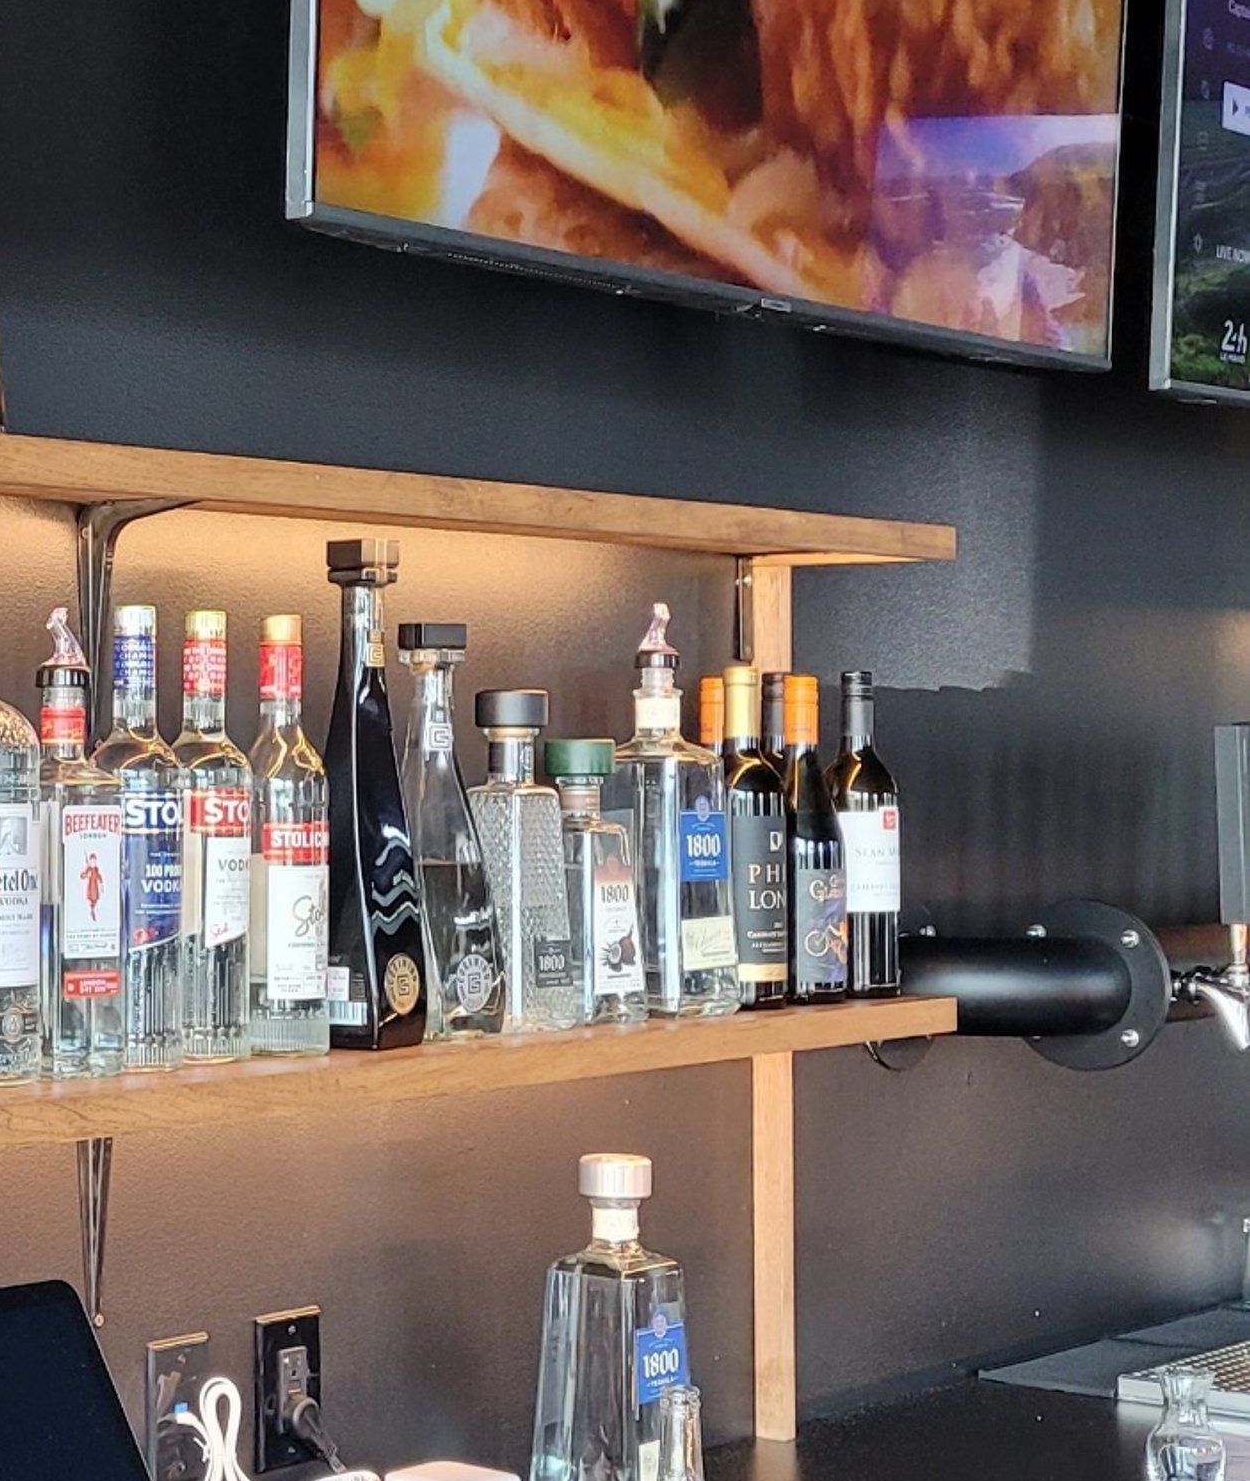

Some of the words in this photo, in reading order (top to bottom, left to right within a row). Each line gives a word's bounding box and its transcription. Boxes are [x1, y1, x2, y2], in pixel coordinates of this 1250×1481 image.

[64, 814, 120, 837] BEEFEATER
[686, 833, 722, 858] 1800
[600, 884, 629, 904] 1800
[538, 954, 565, 972] 1800
[642, 1347, 679, 1377] 1800
